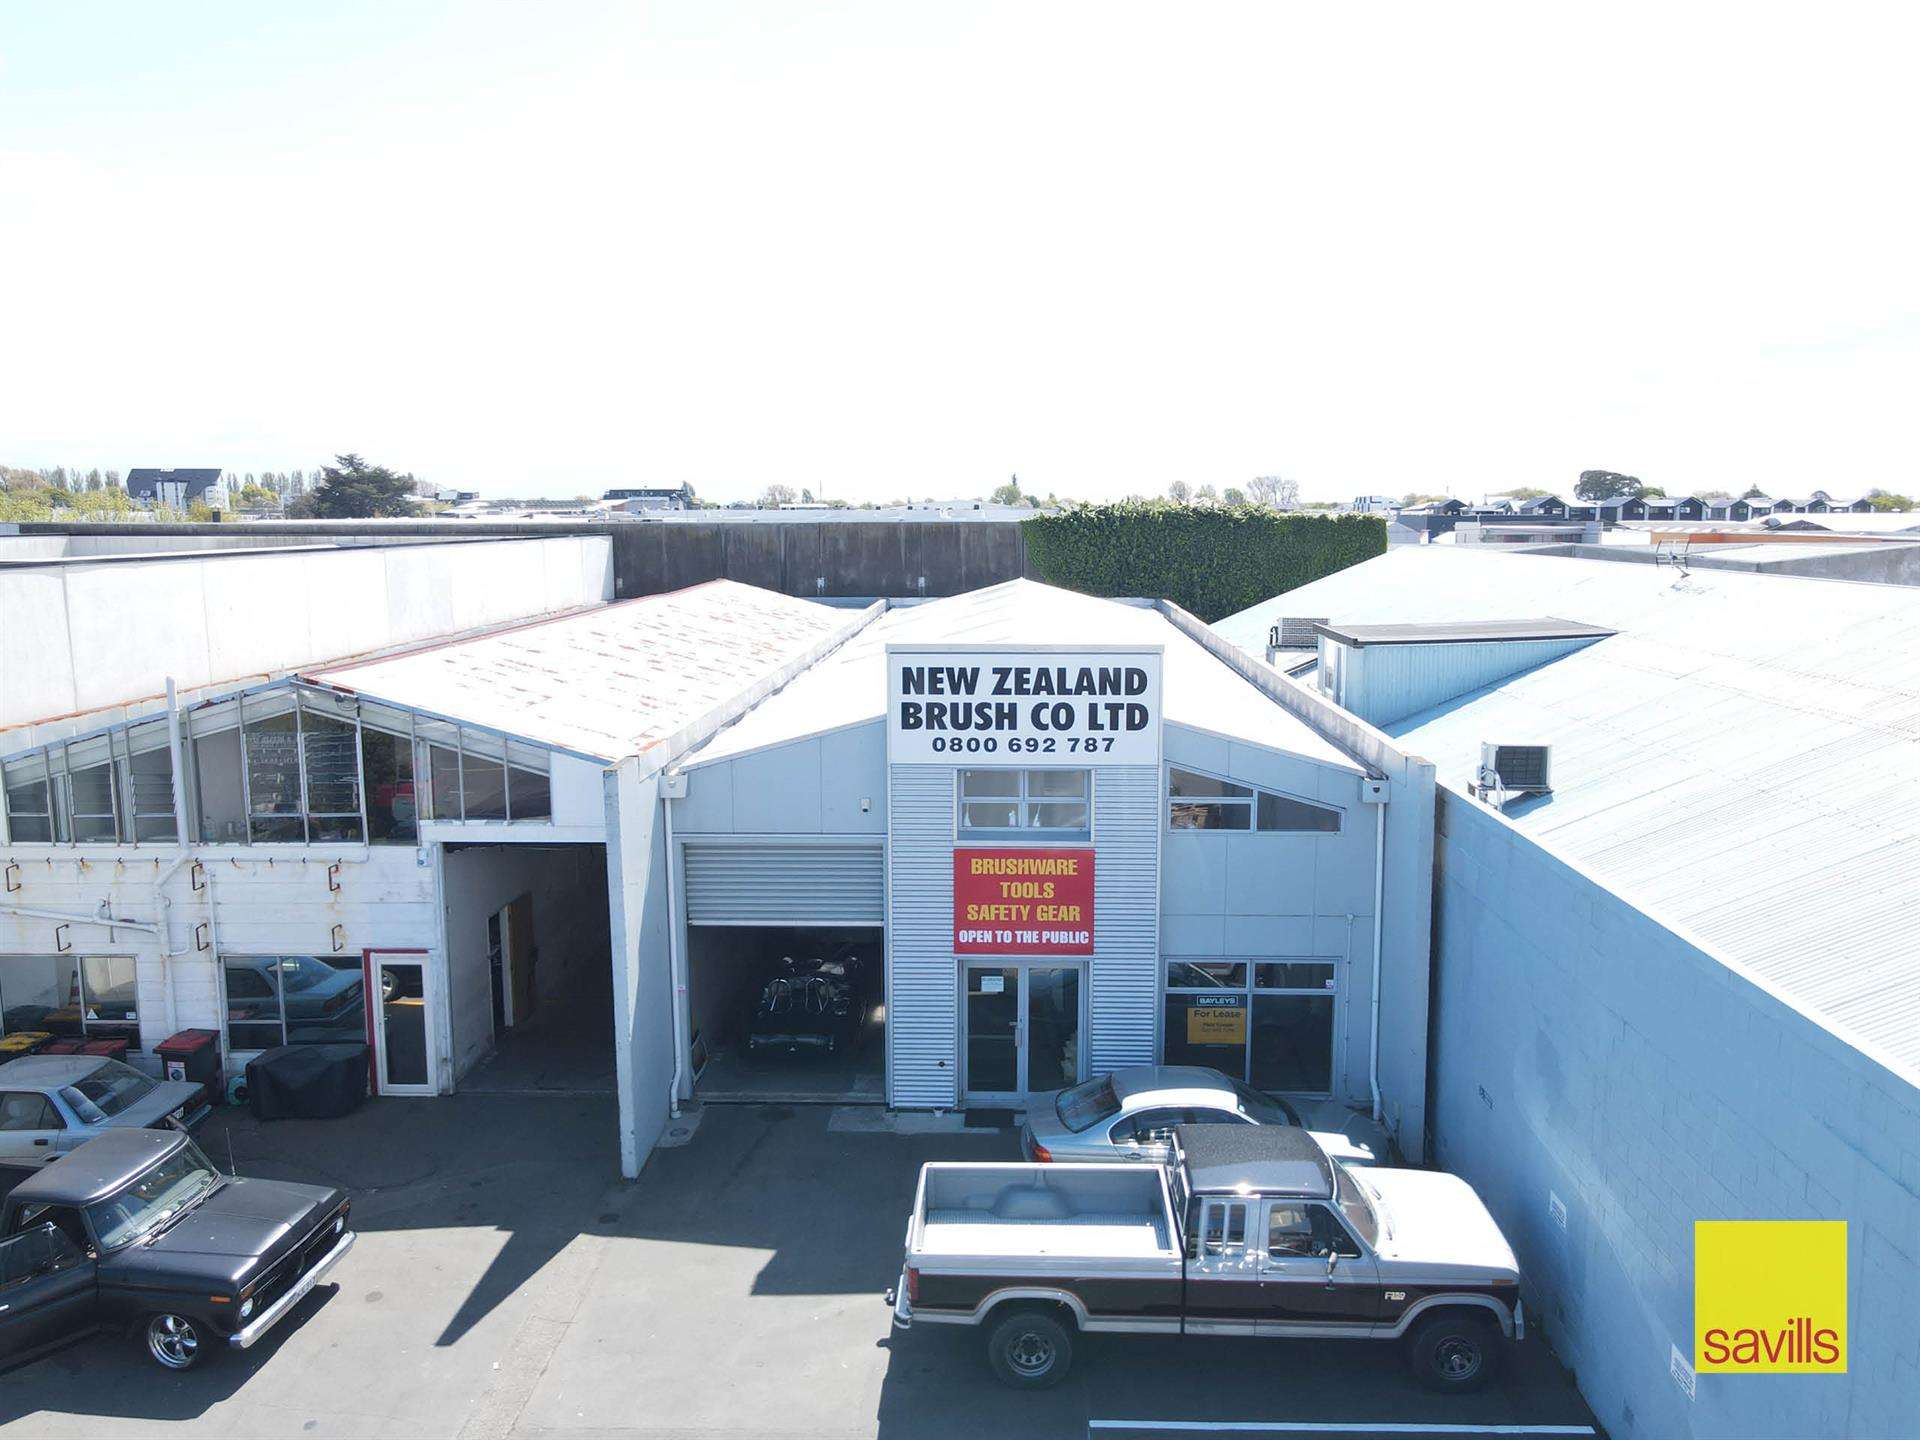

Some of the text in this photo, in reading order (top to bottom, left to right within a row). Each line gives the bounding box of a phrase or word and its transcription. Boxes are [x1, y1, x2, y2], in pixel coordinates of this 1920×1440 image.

[901, 666, 1148, 696] NEW ZEALAND
[901, 702, 1149, 731] BRUSH CO LTD
[932, 737, 1116, 753] 0800 692 787
[970, 858, 1078, 875] BRUSHWARE
[999, 881, 1055, 898] TOOLS
[966, 904, 1081, 922] SAFETY GEAR
[958, 930, 1090, 944] OPEN TO THE PUBLIC
[1194, 1009, 1242, 1018] For Lease
